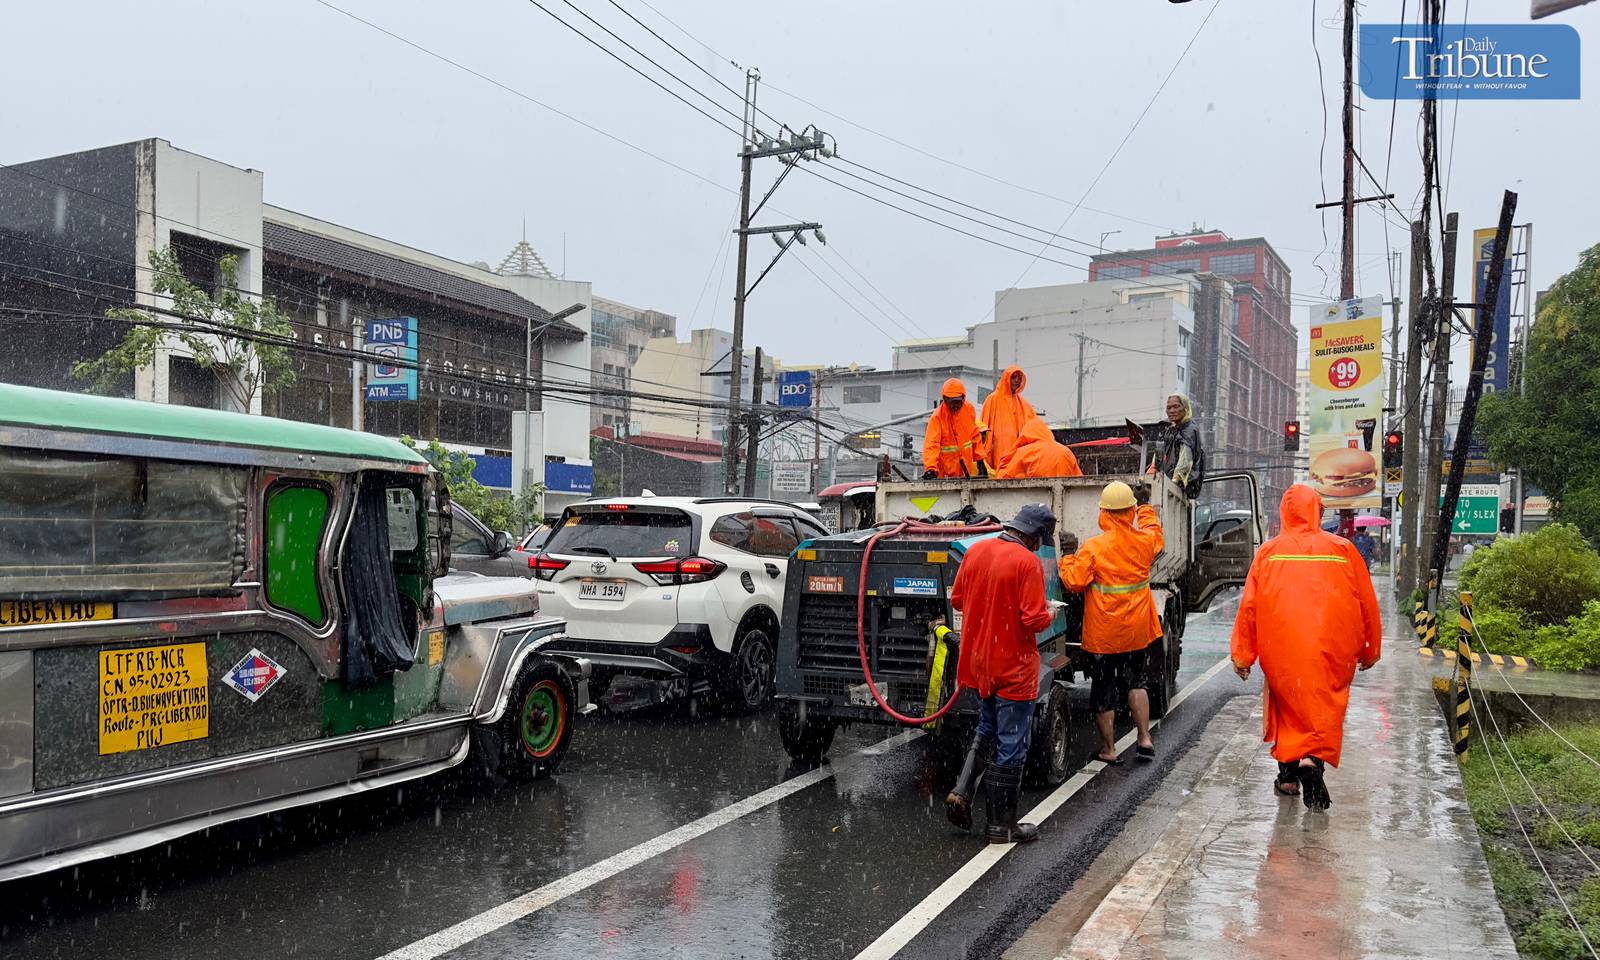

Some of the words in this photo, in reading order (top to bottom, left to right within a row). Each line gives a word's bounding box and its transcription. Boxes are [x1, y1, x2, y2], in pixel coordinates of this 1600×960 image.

[373, 323, 403, 340] PNB
[1325, 335, 1364, 347] McSAVERS
[1315, 345, 1354, 356] SULIT-BUSOG
[1354, 343, 1375, 351] MEALS
[368, 387, 389, 397] ATM
[420, 380, 509, 404] ELLOWSHIP
[1461, 500, 1470, 508] TO
[1473, 510, 1495, 519] SLEX
[581, 585, 597, 595] NHA
[602, 585, 624, 597] 1594
[809, 581, 843, 592] 20km/h
[136, 727, 163, 748] PUJ
